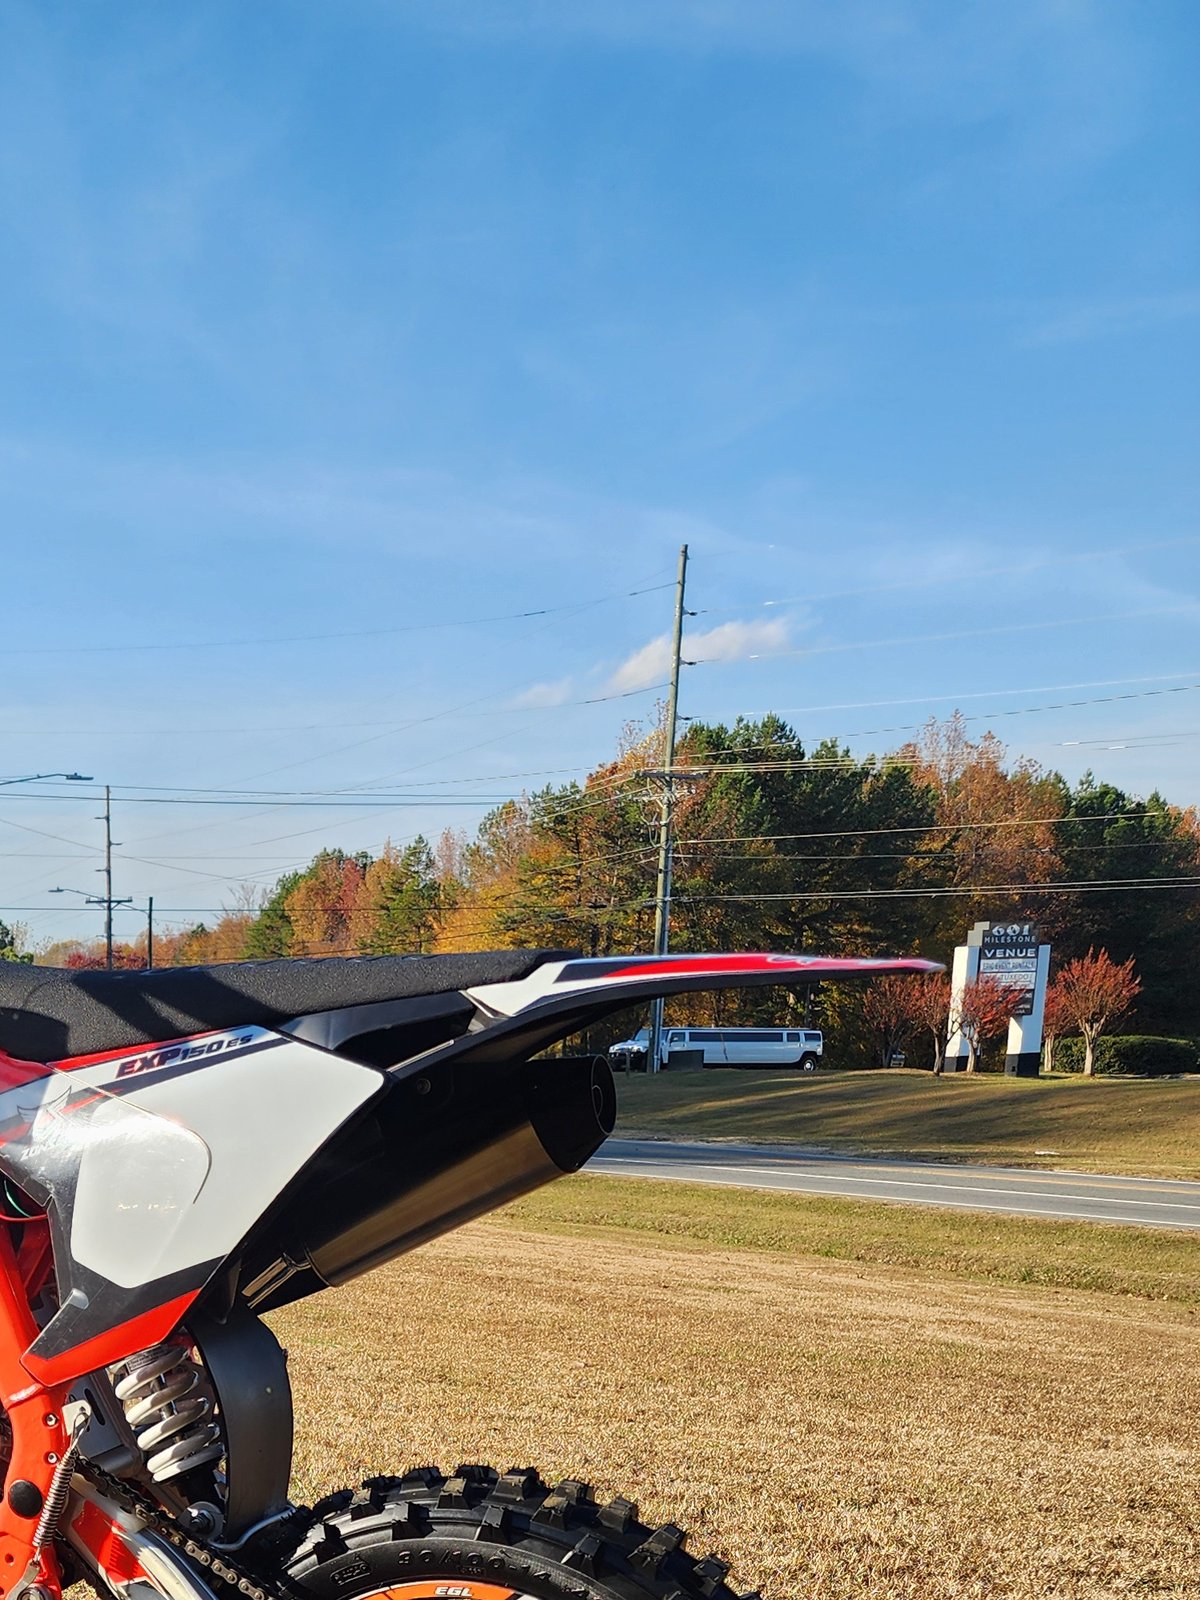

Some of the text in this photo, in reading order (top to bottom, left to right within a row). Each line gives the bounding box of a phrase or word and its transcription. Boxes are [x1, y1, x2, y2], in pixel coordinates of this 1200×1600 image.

[992, 923, 1030, 936] 601
[984, 935, 1036, 943] MILESTONE
[984, 948, 1036, 957] VENUE
[435, 1586, 473, 1597] EGL
